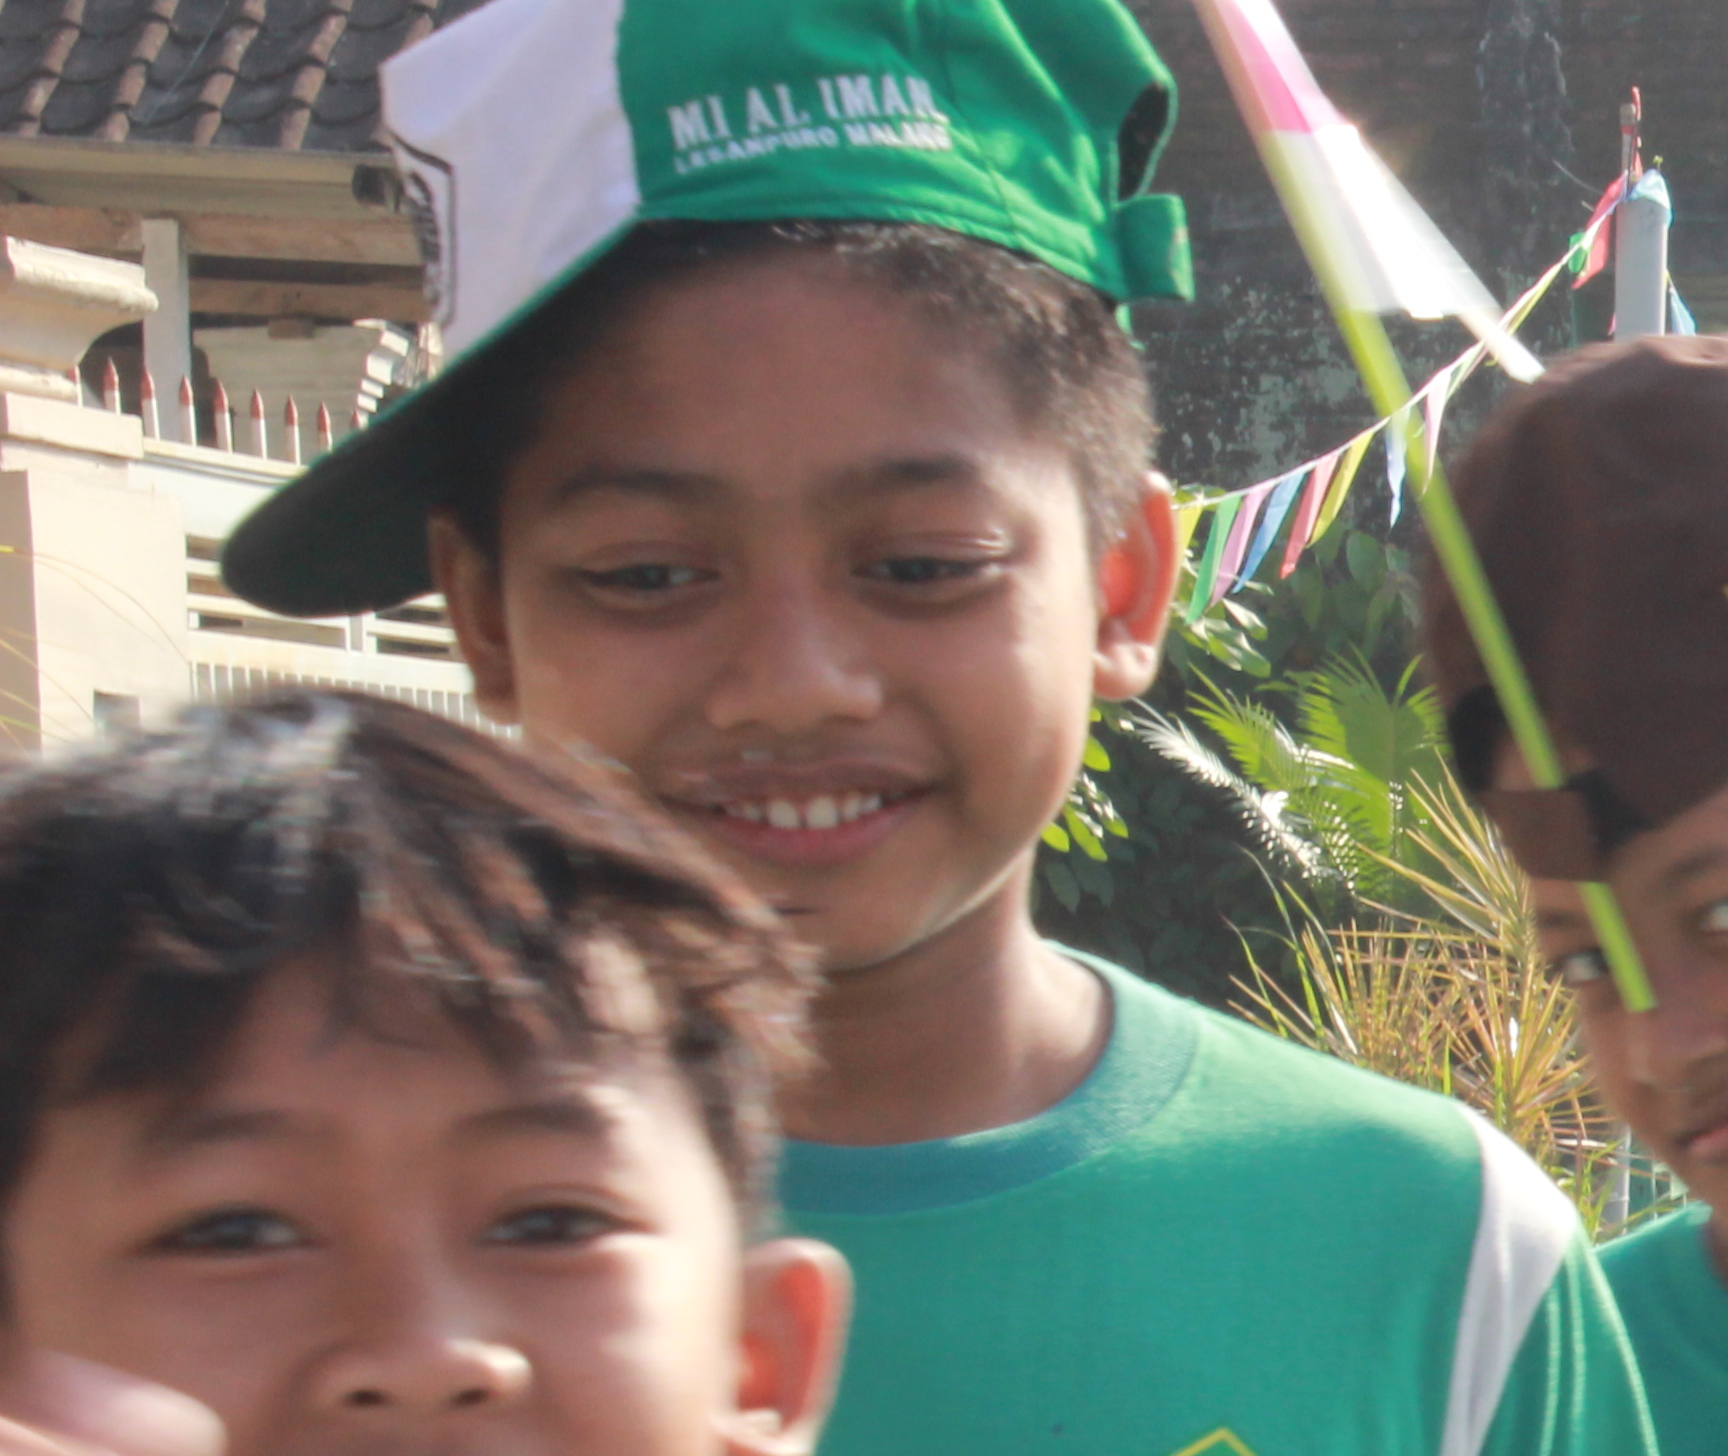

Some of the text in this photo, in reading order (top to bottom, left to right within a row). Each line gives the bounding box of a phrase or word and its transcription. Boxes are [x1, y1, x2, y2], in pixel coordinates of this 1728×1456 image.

[667, 75, 950, 151] MI AL IMAN
